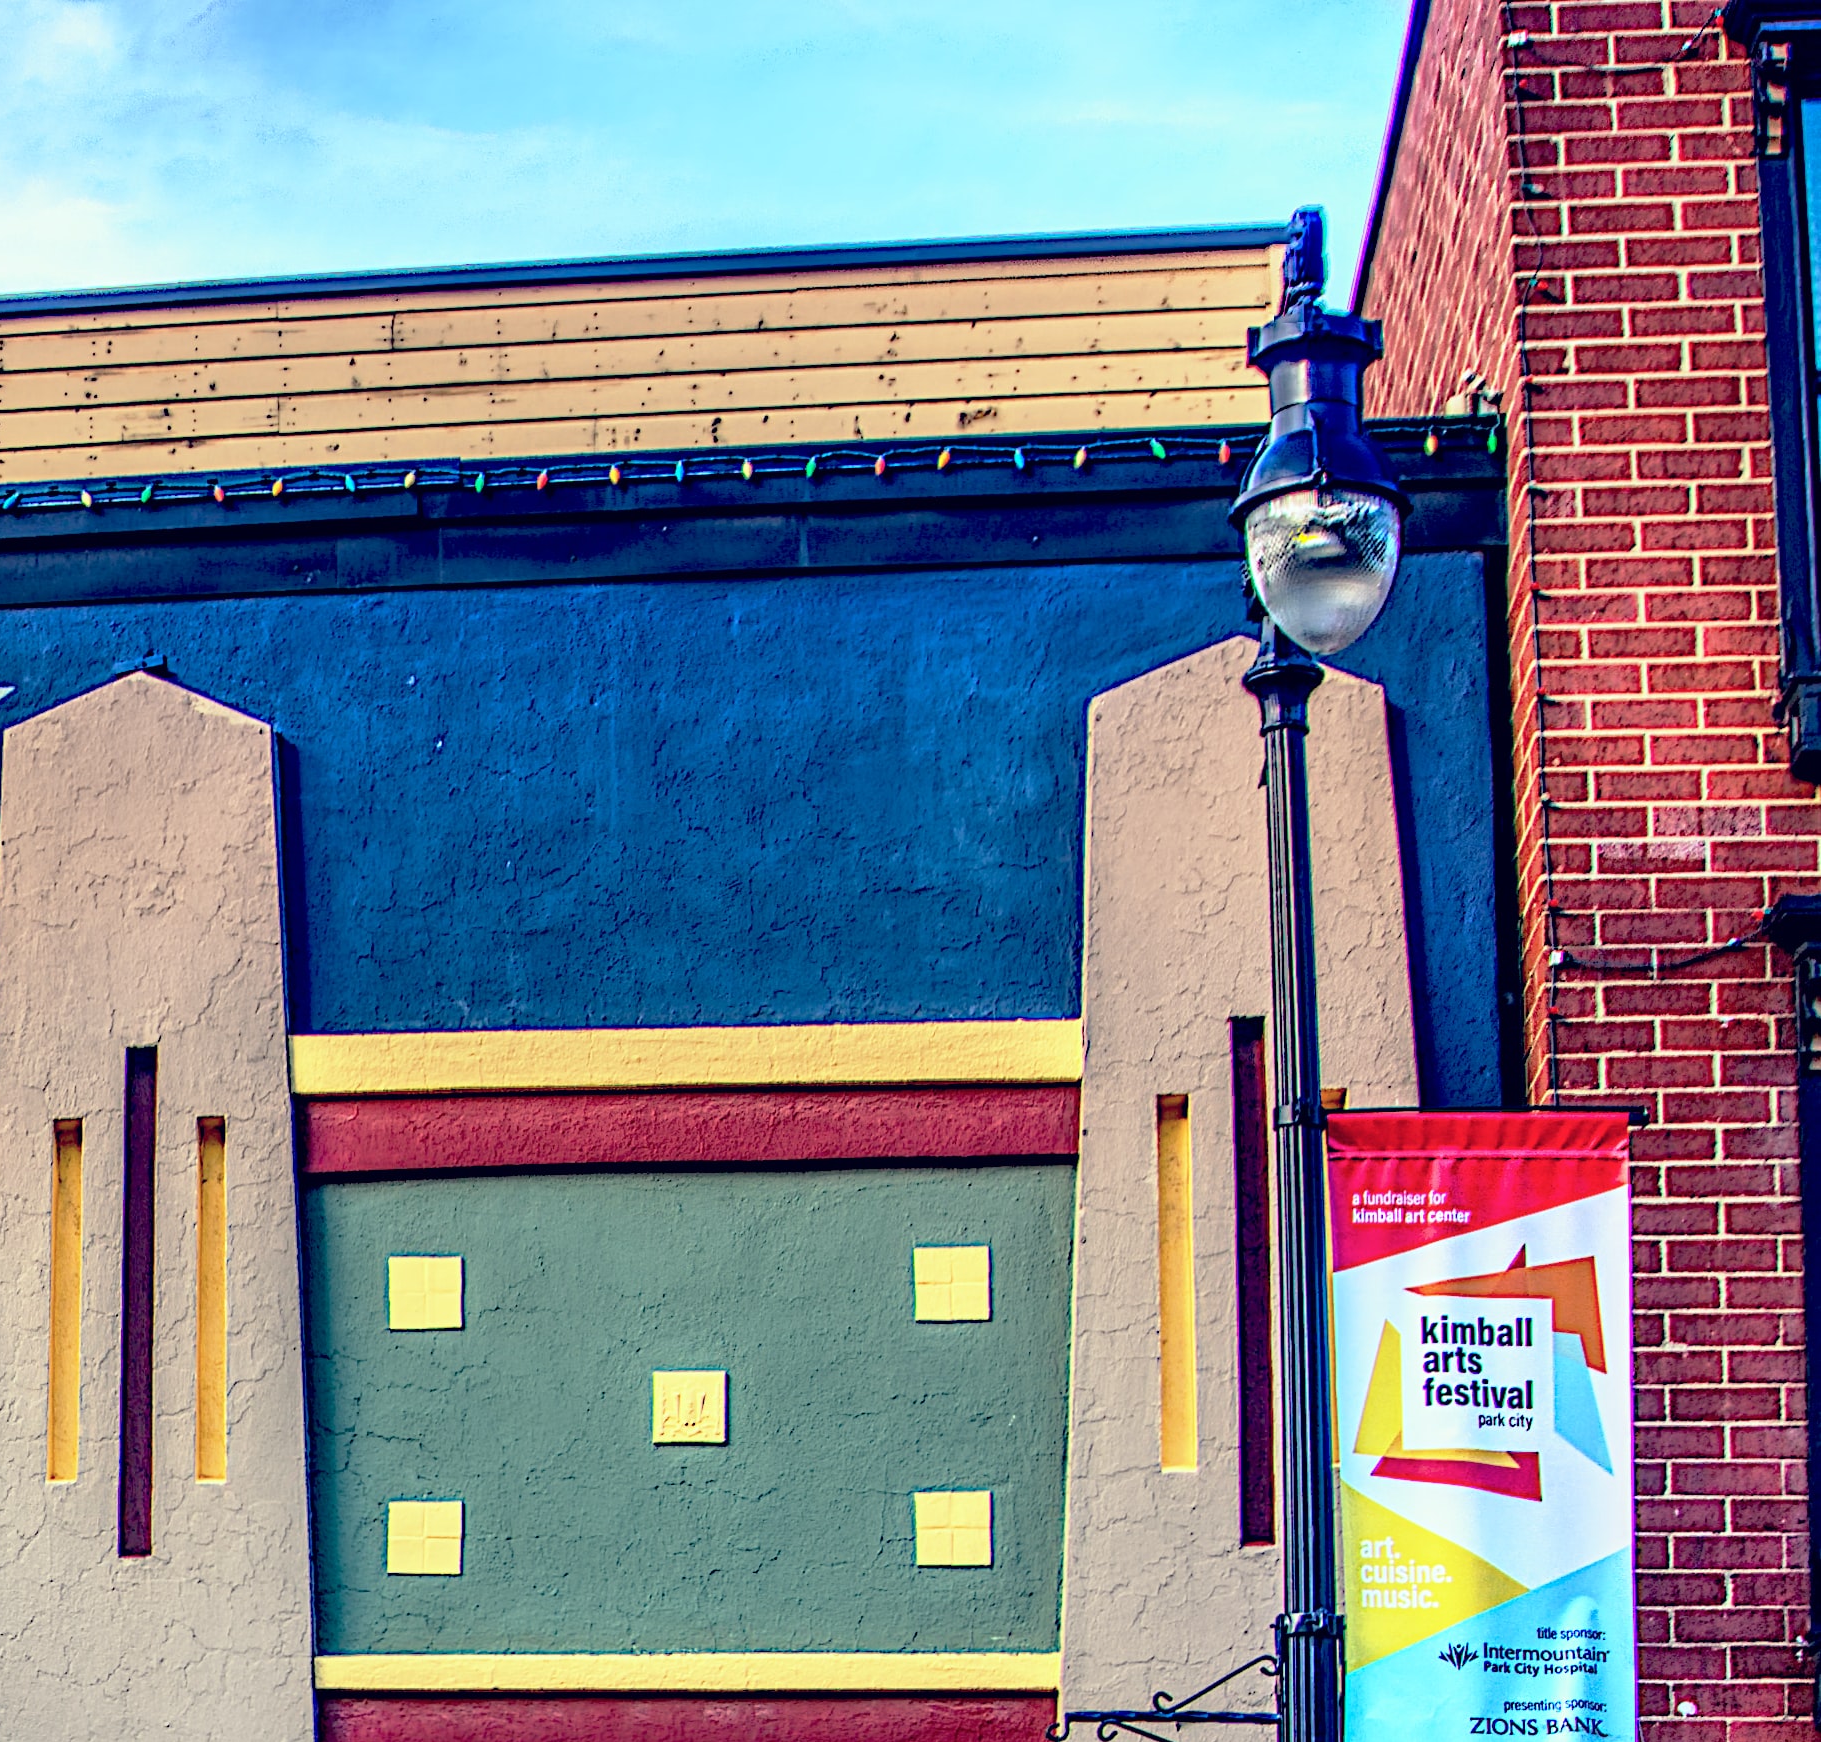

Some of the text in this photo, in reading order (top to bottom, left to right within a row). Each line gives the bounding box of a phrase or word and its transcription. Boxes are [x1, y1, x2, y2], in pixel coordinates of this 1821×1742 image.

[1352, 1189, 1447, 1206] a fundraiser for
[1352, 1207, 1471, 1224] kimball art center
[1420, 1314, 1533, 1347] kimball
[1422, 1346, 1483, 1375] arts
[1422, 1376, 1534, 1410] festival
[1478, 1413, 1533, 1431] park city
[1360, 1536, 1402, 1560] art.
[1360, 1558, 1454, 1584] cuisine.
[1361, 1583, 1441, 1609] music.
[1536, 1626, 1607, 1642] title sponsor:
[1483, 1641, 1609, 1663] Intermountain
[1483, 1660, 1598, 1678] Park City Hospital
[1503, 1699, 1608, 1714] presenting sponsor:
[1469, 1715, 1609, 1738] ZIONS BANK
